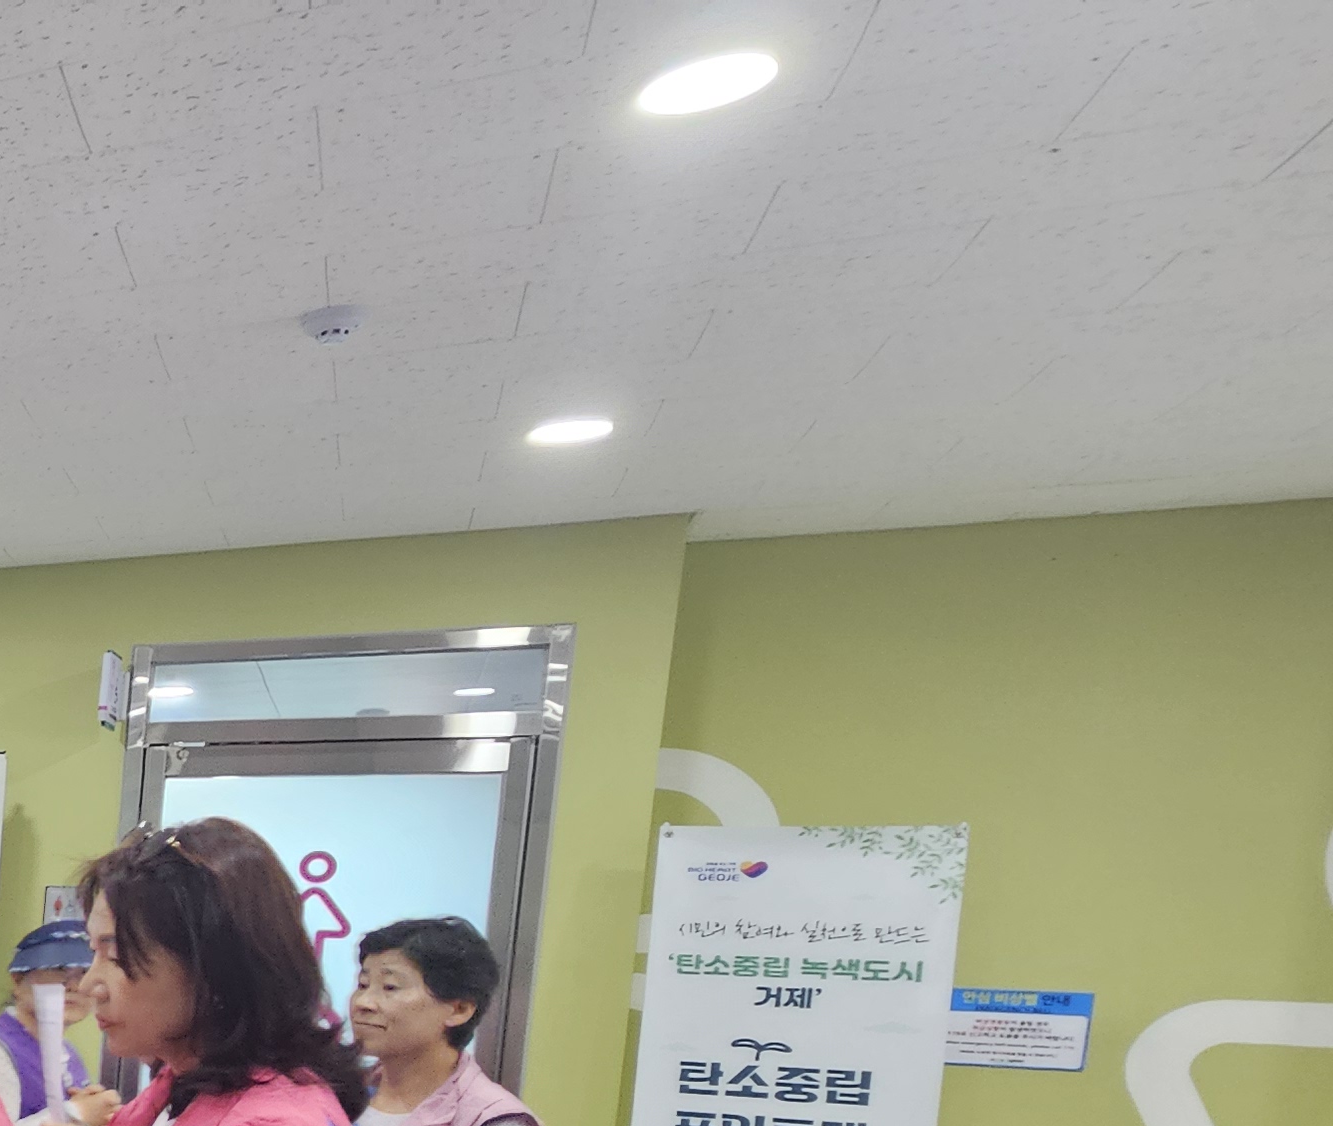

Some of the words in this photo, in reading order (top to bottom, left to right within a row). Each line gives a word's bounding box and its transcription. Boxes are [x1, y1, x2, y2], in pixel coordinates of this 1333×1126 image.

[697, 873, 740, 882] GEOJE
[679, 920, 727, 938] 시민의
[735, 918, 795, 940] 참여와
[800, 920, 867, 943] 실천으로
[873, 926, 931, 945] 만드는
[800, 958, 924, 983] 녹색도시
[678, 1061, 873, 1106] 탄소중립
